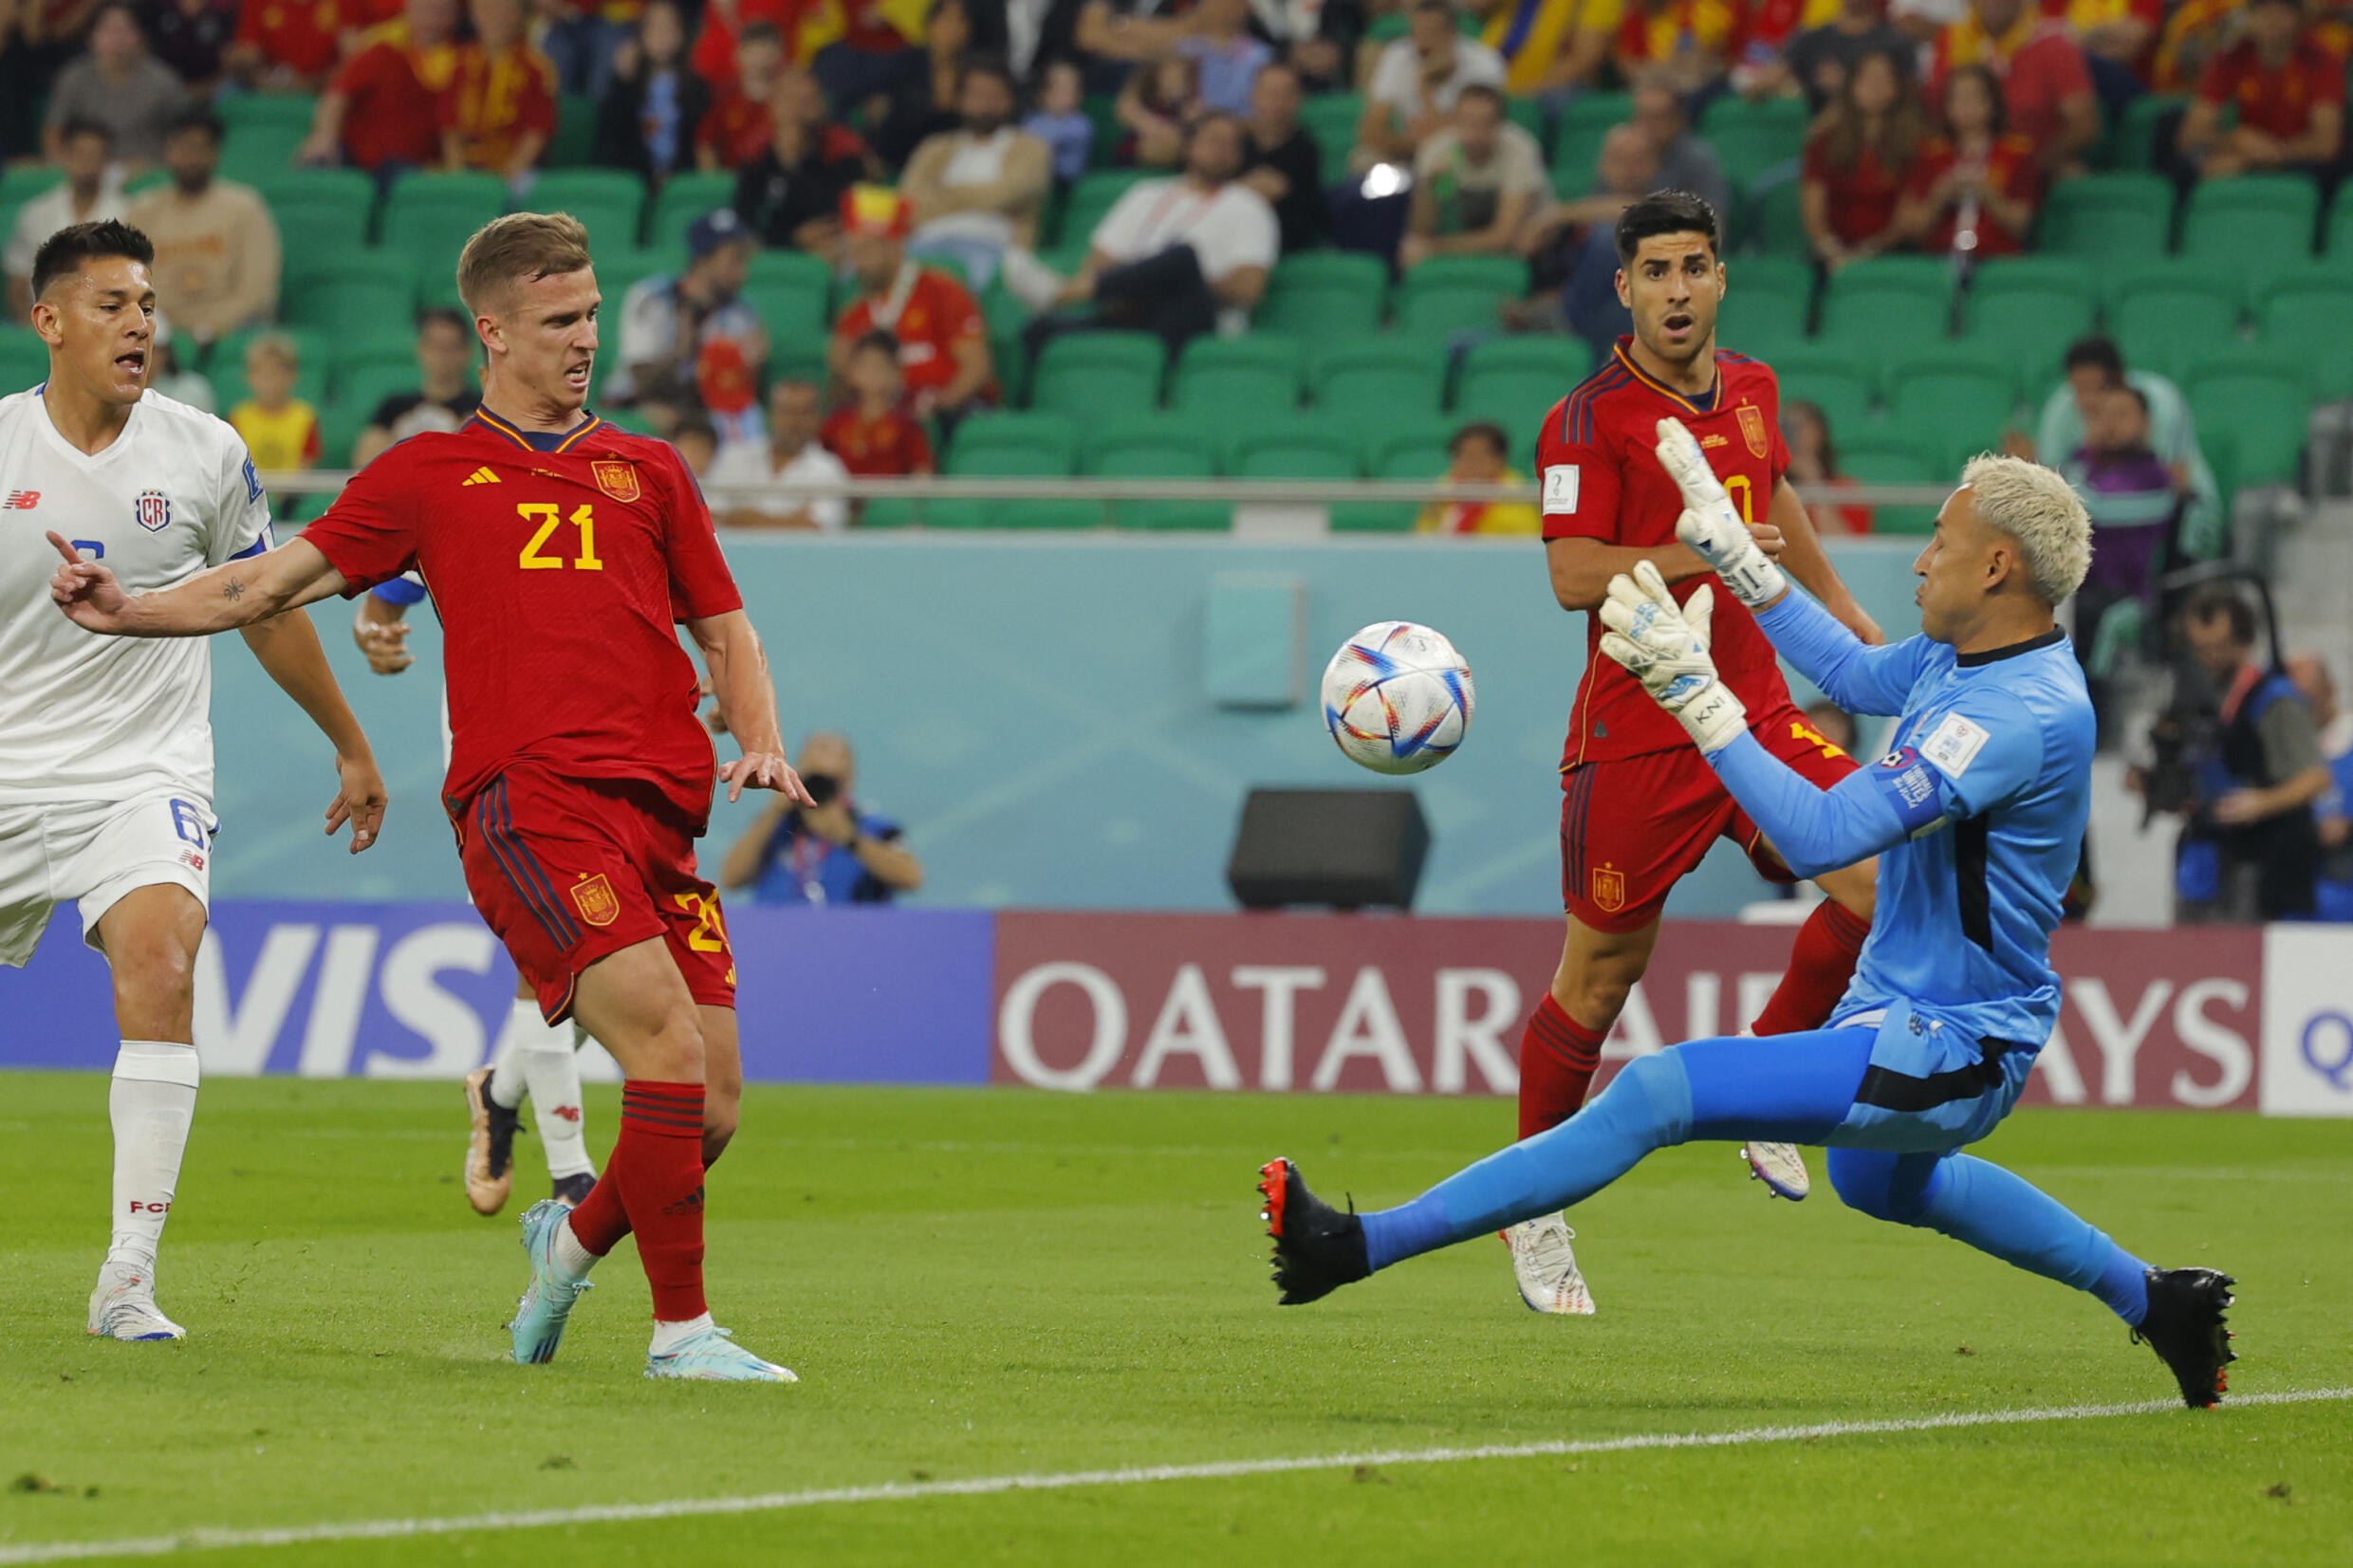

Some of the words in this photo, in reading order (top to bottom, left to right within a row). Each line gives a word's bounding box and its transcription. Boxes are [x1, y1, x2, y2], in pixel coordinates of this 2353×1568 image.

[143, 498, 163, 525] CR
[517, 503, 603, 570] 21
[1901, 770, 1927, 803] UNITES
[170, 799, 204, 850] 6
[192, 923, 621, 1079] VIS
[999, 961, 1522, 1093] QATAR
